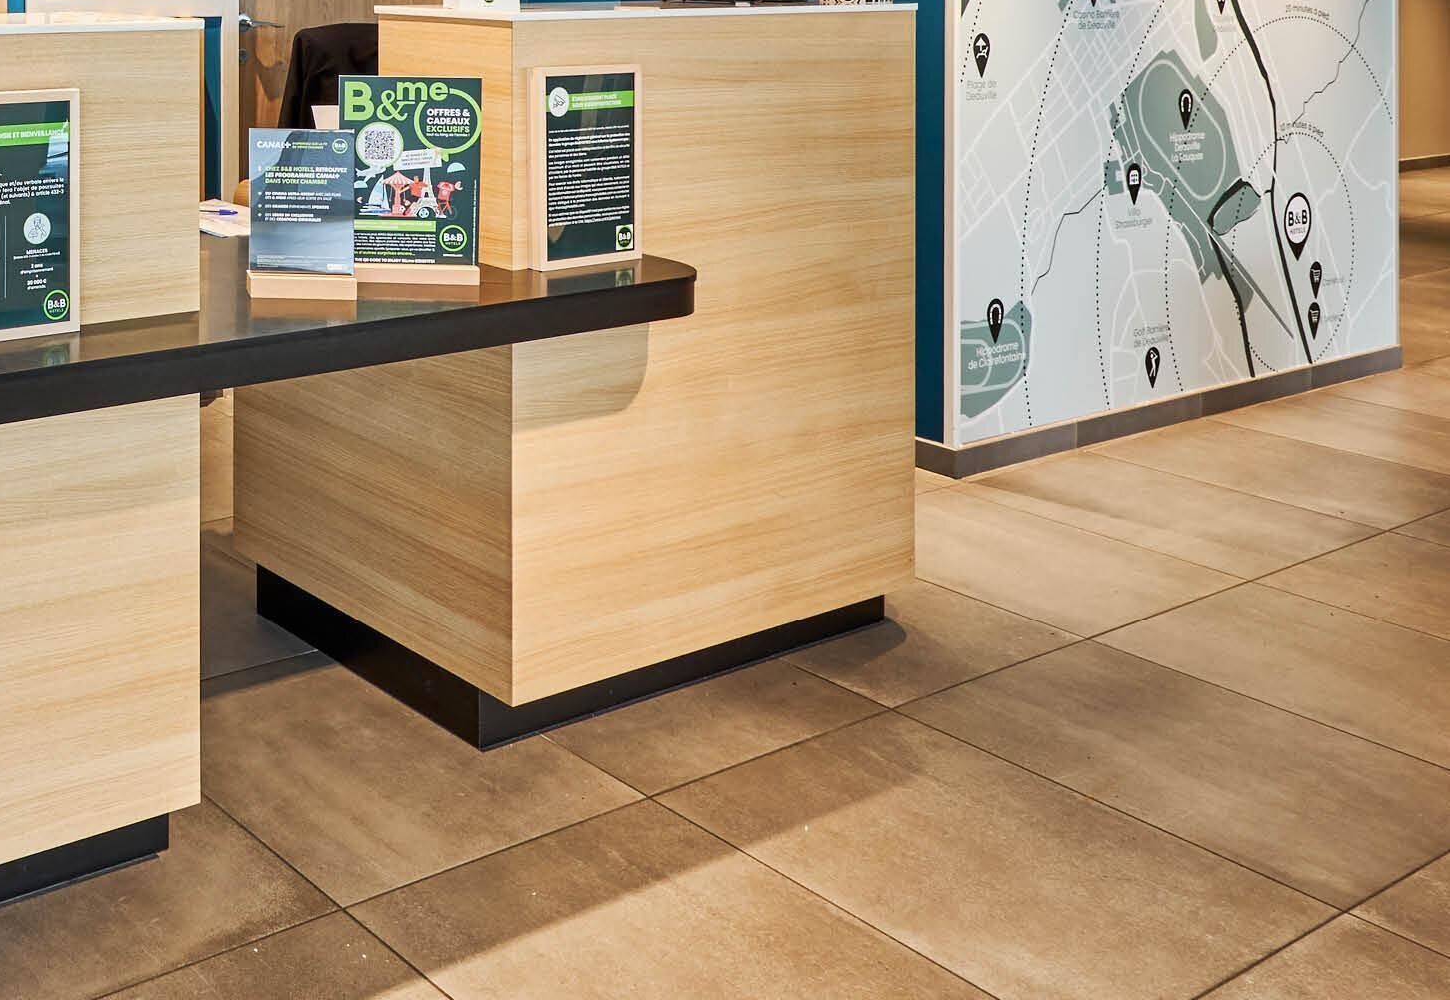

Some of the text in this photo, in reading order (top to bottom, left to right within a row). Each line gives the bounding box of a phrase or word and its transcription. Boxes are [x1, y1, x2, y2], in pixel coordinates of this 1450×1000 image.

[344, 81, 448, 121] B&me
[1288, 210, 1308, 226] B&B
[444, 233, 463, 242] B&B
[48, 299, 66, 309] B&B
[976, 342, 1018, 357] Hippodrome
[968, 360, 978, 369] de
